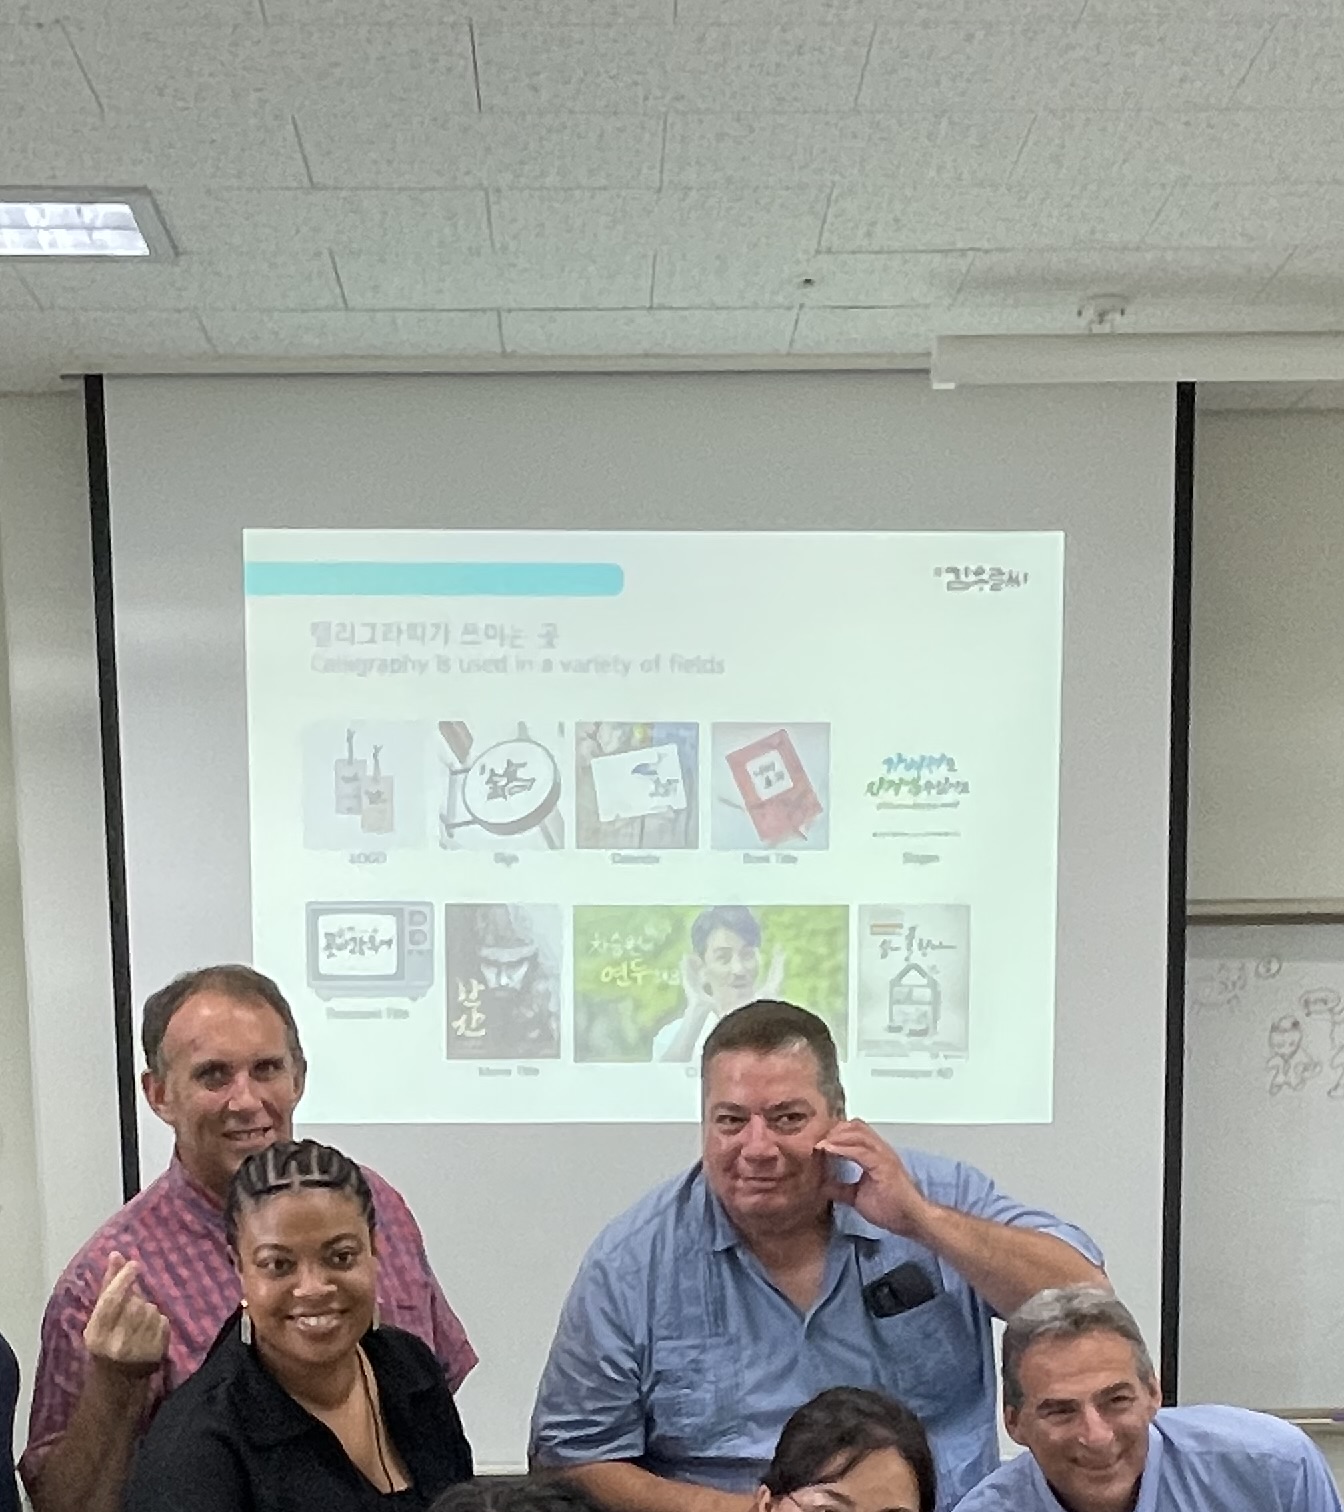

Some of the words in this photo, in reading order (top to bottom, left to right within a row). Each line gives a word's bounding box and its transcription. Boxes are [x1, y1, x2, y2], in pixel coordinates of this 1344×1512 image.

[458, 655, 508, 674] used
[559, 654, 632, 677] variety
[640, 653, 661, 673] of
[669, 653, 726, 674] fields
